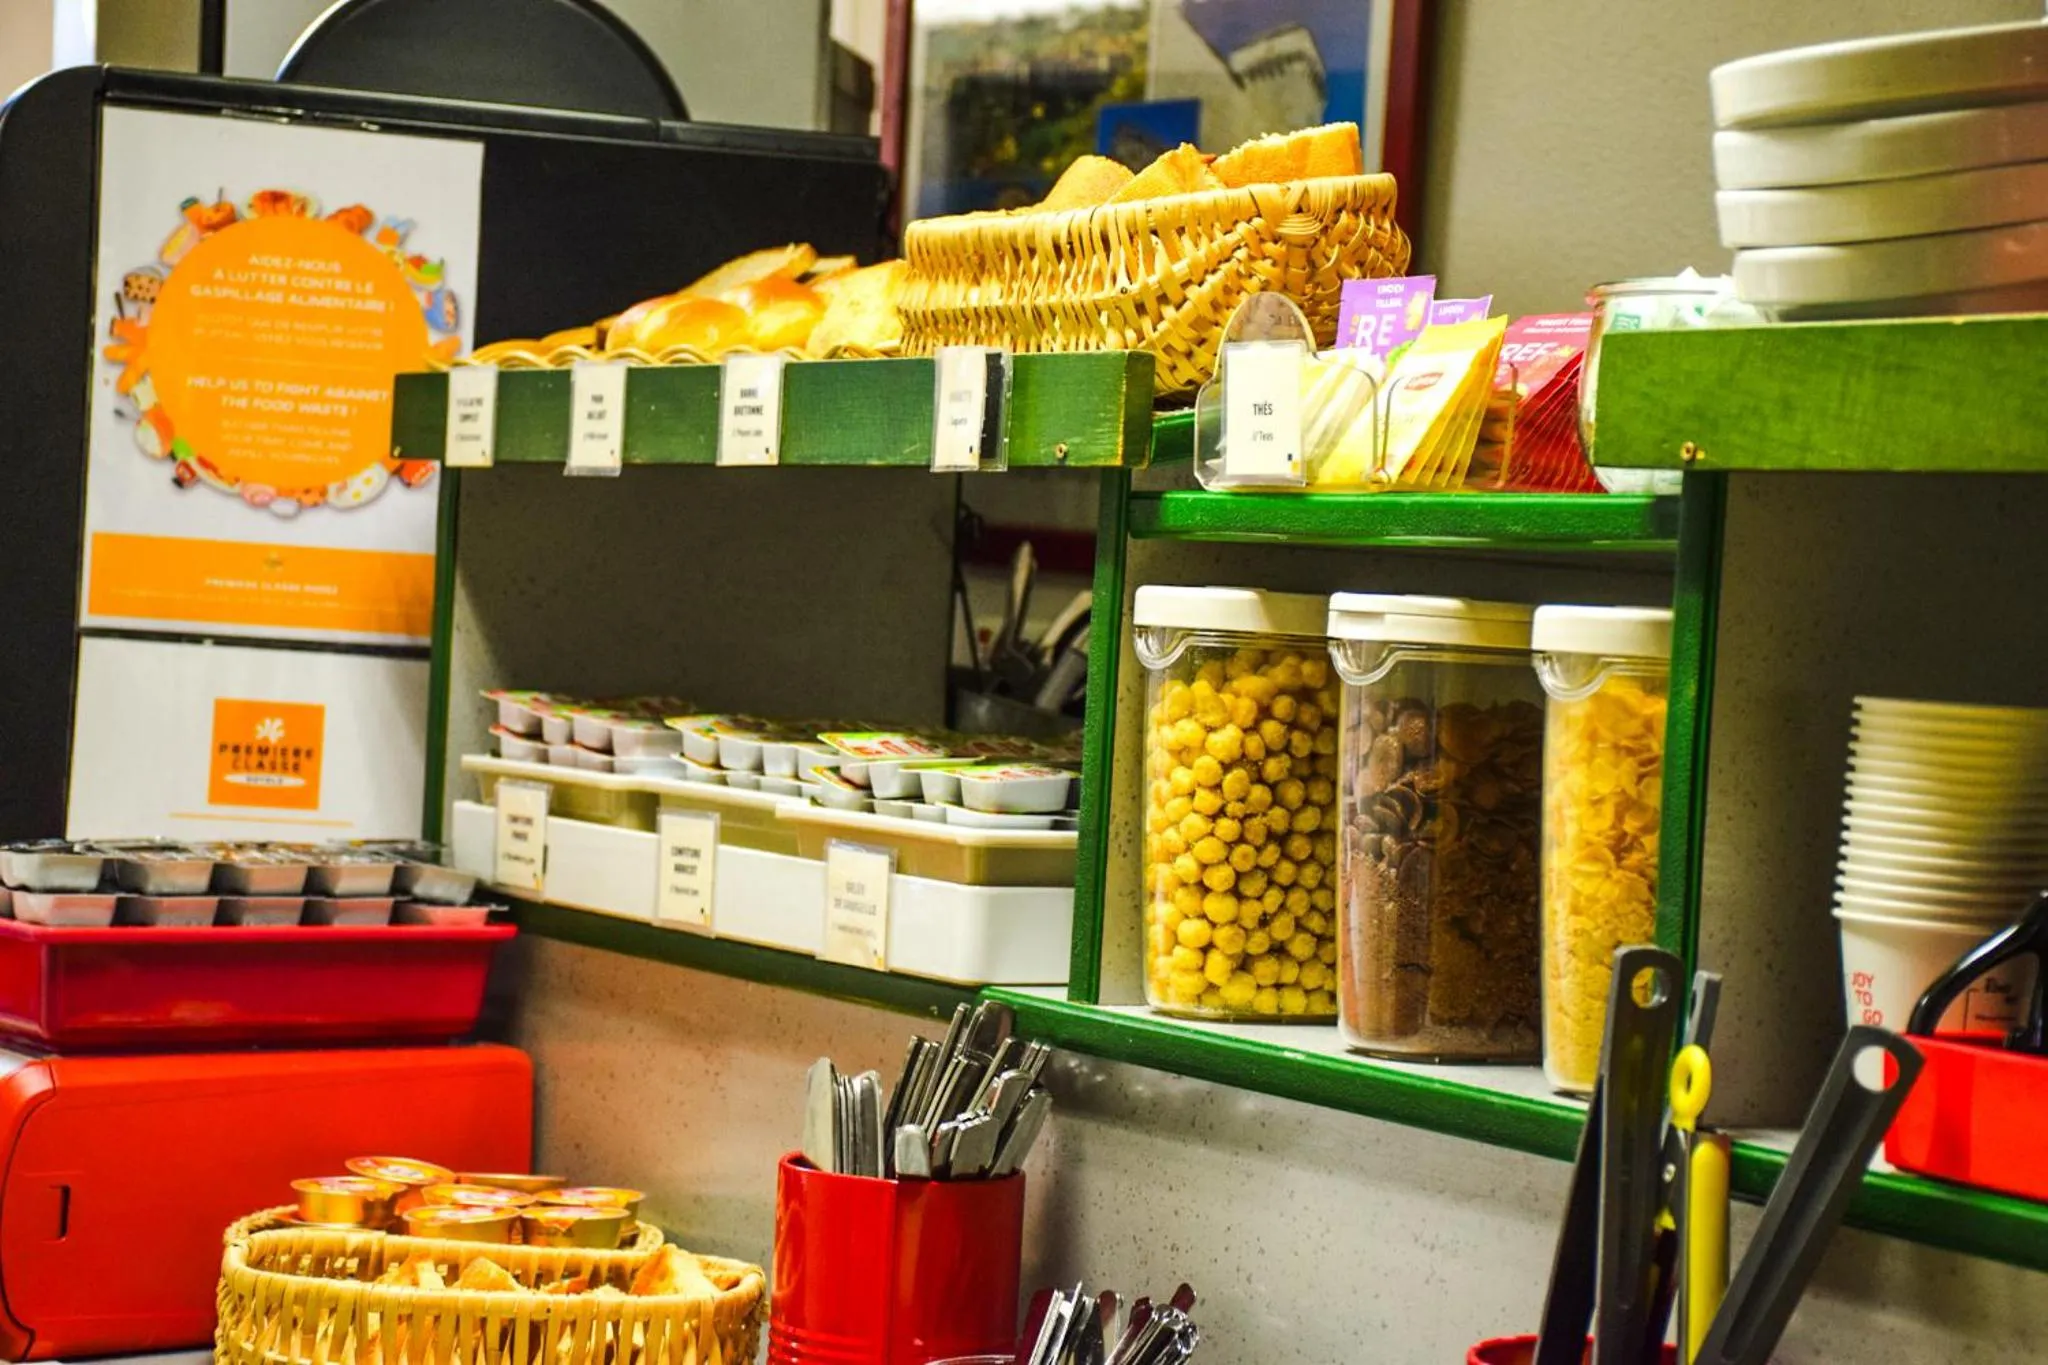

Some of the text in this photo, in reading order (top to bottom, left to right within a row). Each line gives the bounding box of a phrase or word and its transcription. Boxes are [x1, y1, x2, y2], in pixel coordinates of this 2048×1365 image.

[249, 254, 342, 273] AIDEZ-NOUS
[229, 269, 287, 286] LUTTER
[291, 274, 352, 293] CONTRE
[356, 281, 374, 295] LE
[190, 284, 284, 304] GASPILLAGE
[187, 376, 389, 402] HELP US TO FIGHT AGAINST
[221, 396, 248, 409] THE
[253, 397, 294, 412] FOOD
[299, 402, 348, 417] WASTE
[1253, 400, 1273, 416] THÉS
[1852, 971, 1874, 988] JOY
[1855, 990, 1873, 1006] TO
[1863, 1009, 1882, 1025] GO
